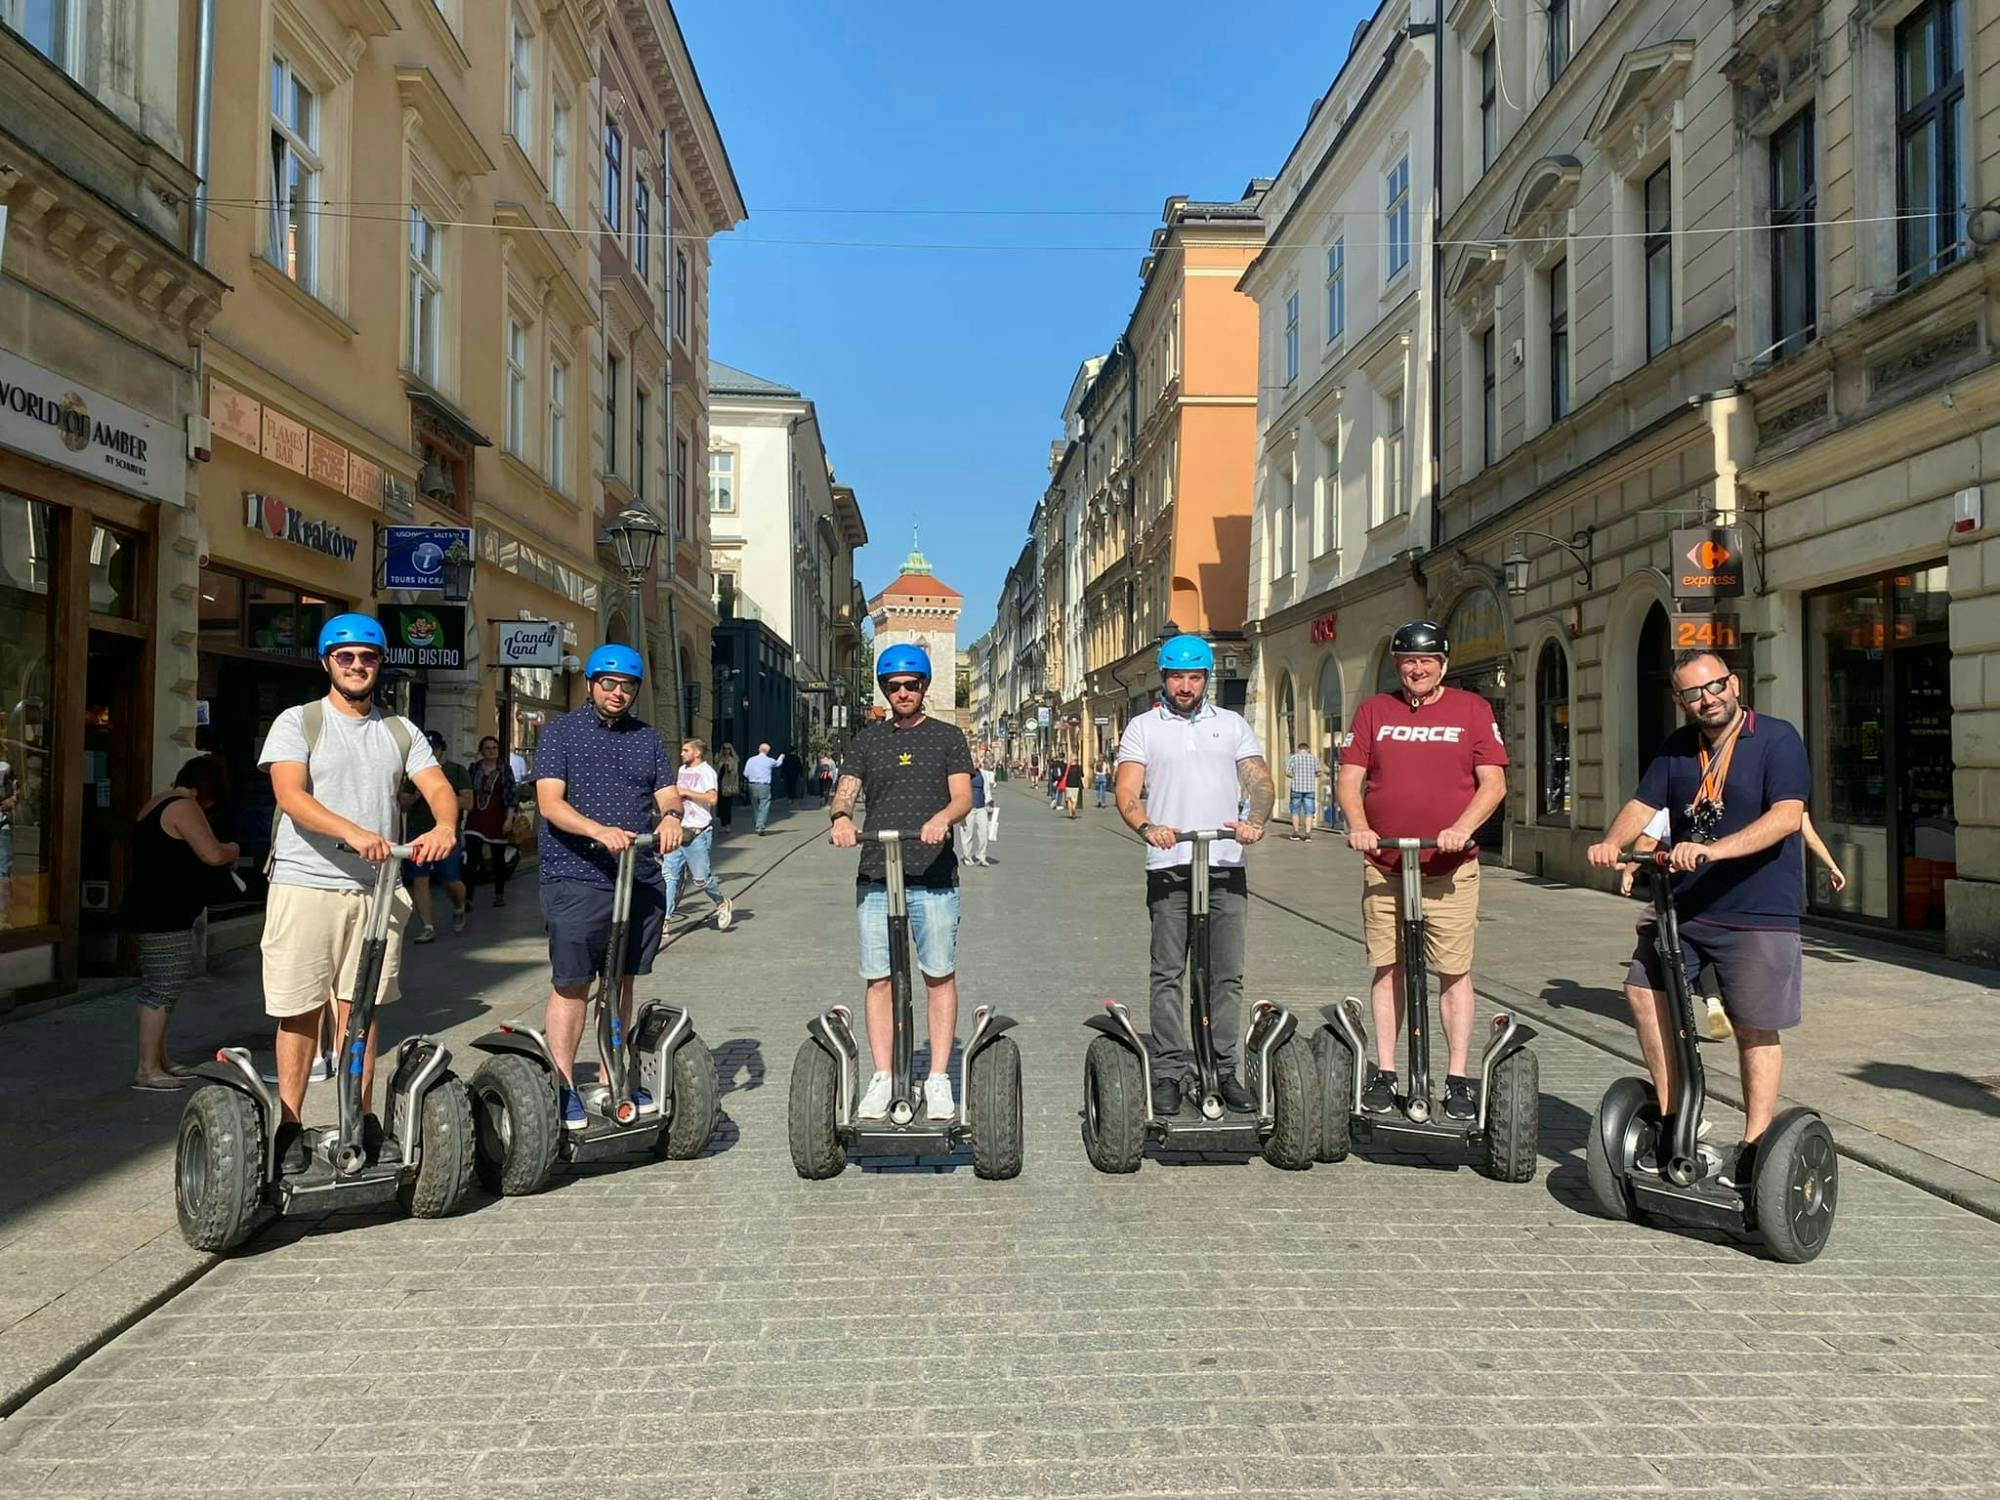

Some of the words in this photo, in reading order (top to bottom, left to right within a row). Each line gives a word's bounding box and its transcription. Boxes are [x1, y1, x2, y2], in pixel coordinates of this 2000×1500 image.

[93, 420, 147, 462] AMBER
[267, 419, 304, 452] FLAMES
[275, 442, 294, 465] BAR
[286, 507, 357, 562] Kraków
[390, 575, 416, 584] TOURS
[417, 576, 428, 584] IN
[1682, 575, 1737, 588] express
[514, 630, 555, 647] Candy
[1677, 622, 1735, 646] 24h
[384, 647, 415, 665] SUMO
[418, 649, 459, 666] BISTRO
[504, 637, 538, 660] Land
[1376, 725, 1463, 743] FORCE
[357, 1028, 366, 1039] 2
